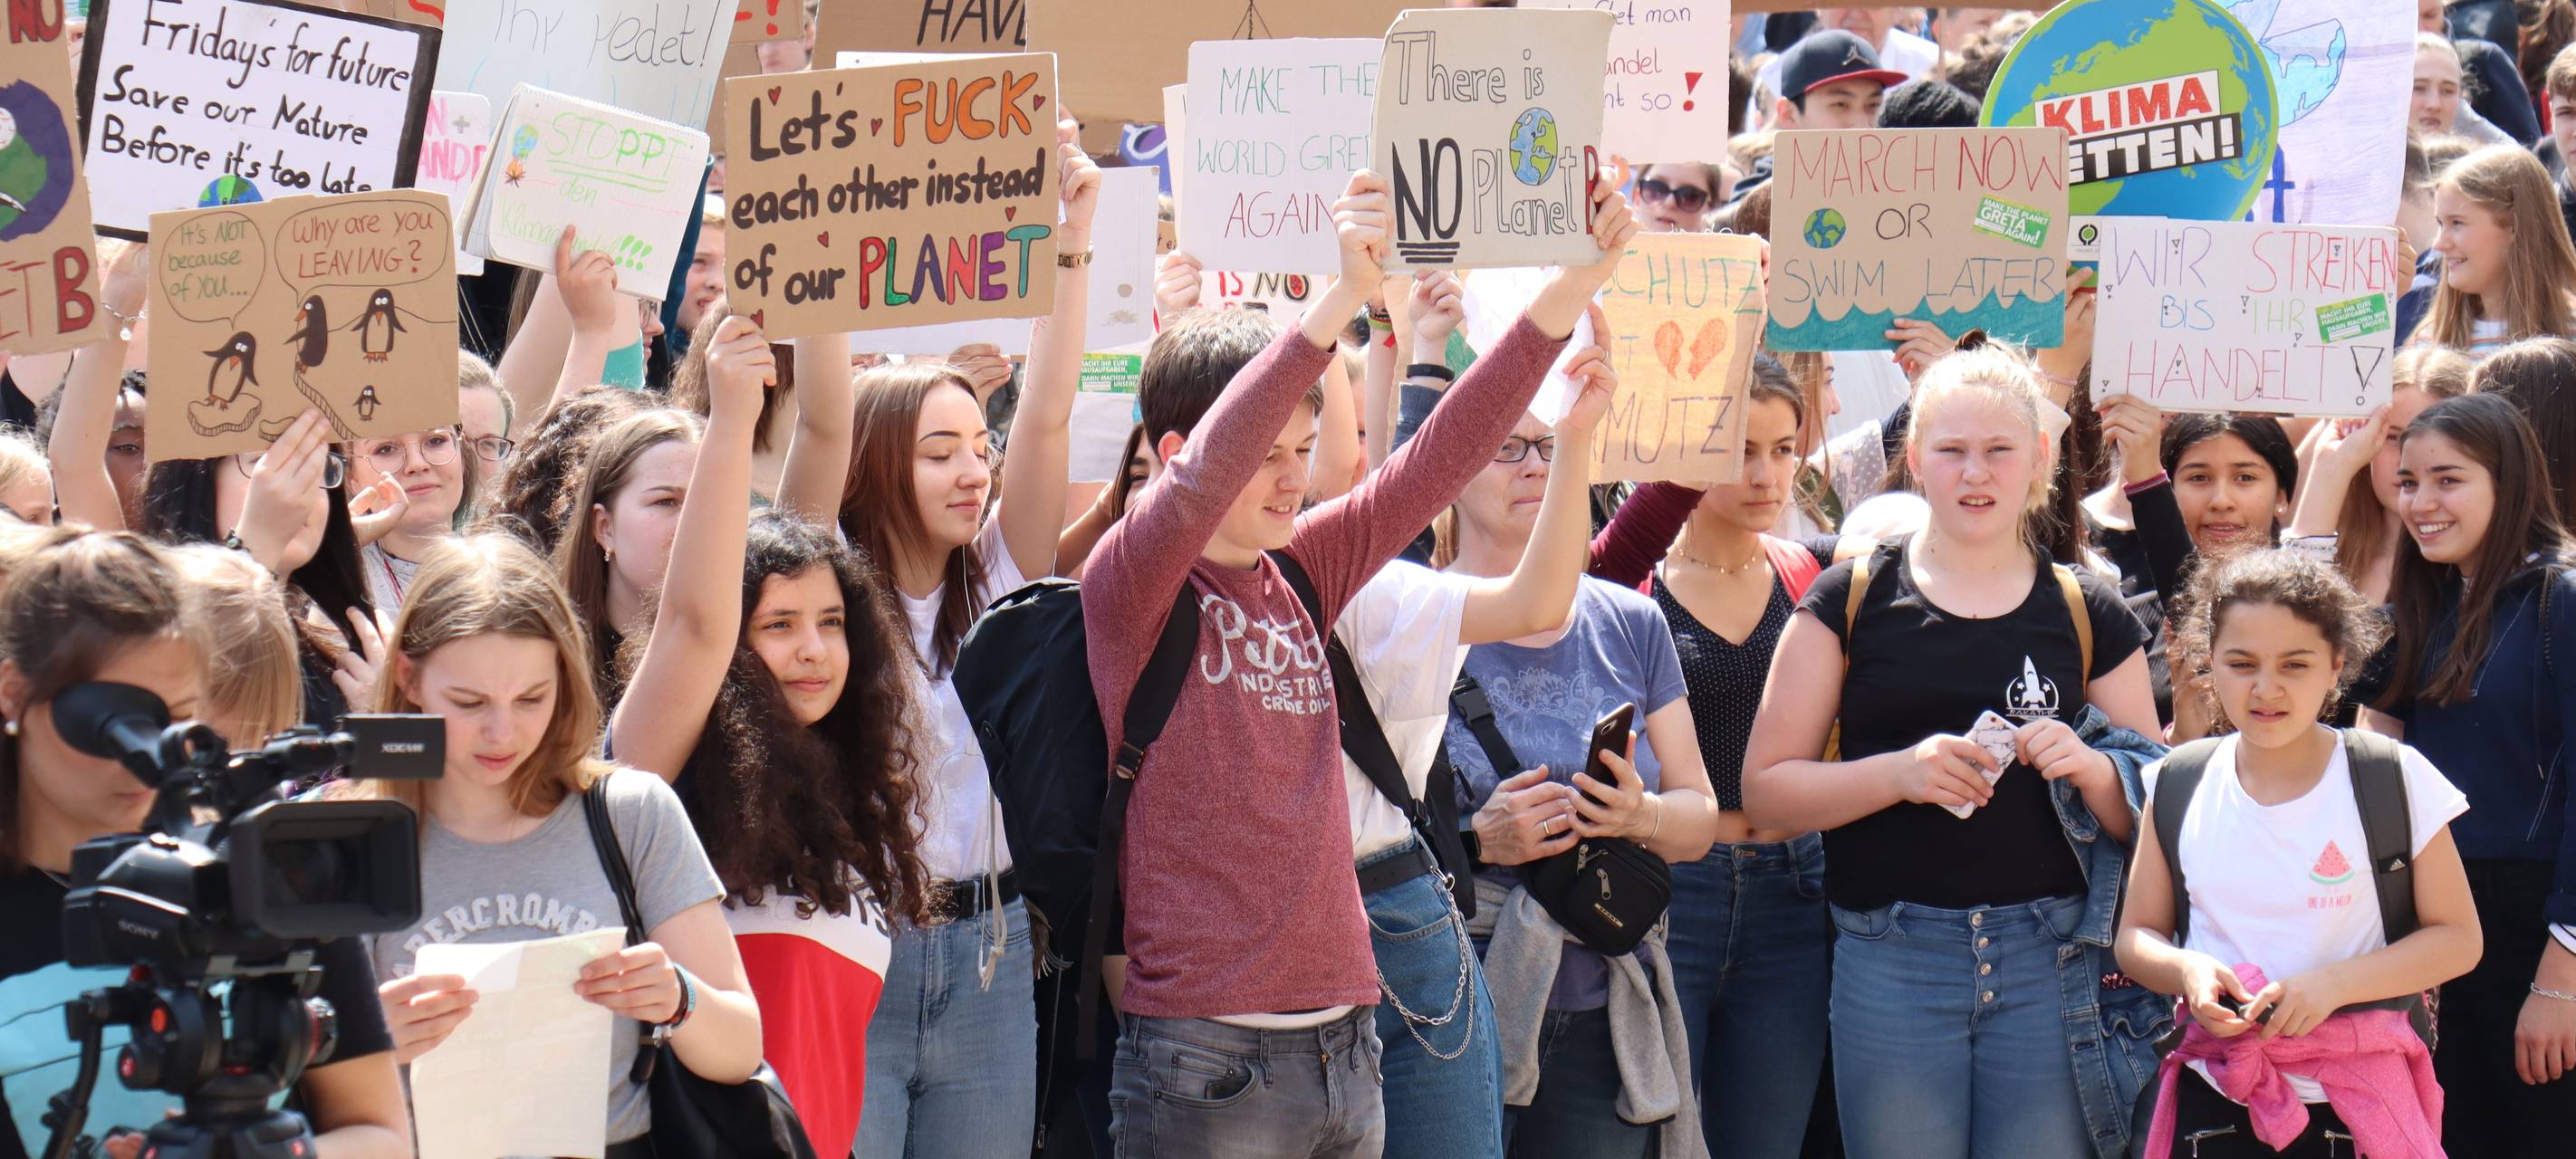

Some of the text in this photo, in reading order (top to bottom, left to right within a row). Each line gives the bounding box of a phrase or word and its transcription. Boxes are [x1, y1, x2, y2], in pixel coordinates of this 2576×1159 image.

[587, 0, 721, 68] redet!
[1646, 7, 1691, 23] man
[286, 22, 323, 74] for
[327, 36, 410, 91] future
[1391, 31, 1544, 104] There is
[102, 64, 368, 145] Save our Nature
[749, 82, 858, 161] Let's
[894, 71, 1038, 147] FUCK
[1219, 66, 1293, 115] MAKE
[1309, 62, 1379, 96] THE
[2043, 77, 2213, 137] KLIMA
[101, 114, 211, 170] Before
[224, 141, 262, 179] it's
[270, 149, 312, 189] too
[545, 112, 687, 177] STOPPT
[1197, 138, 1286, 177] WORLD
[1790, 133, 2064, 200] MARCH NOW
[560, 177, 598, 206] den
[732, 148, 1045, 229] each other instead
[1392, 138, 1463, 241] NO
[1472, 146, 1578, 236] Planet
[1984, 198, 2049, 225] MAKE THE PLANET
[215, 219, 249, 242] NOT
[293, 211, 433, 249] Why are you
[1876, 203, 1933, 239] OR
[1981, 206, 2026, 232] GRETA
[2004, 227, 2042, 244] AGAIN!
[168, 249, 242, 273] because
[299, 239, 422, 279] LEAVING?
[734, 225, 1052, 310] of our PLANET
[1784, 257, 2058, 302] SWIM LATER
[2113, 226, 2398, 294] WIR STREIKEN
[169, 274, 193, 302] of
[2159, 294, 2215, 330] BIS
[2254, 298, 2305, 335] IHR
[2125, 340, 2339, 403] HANDELT
[1200, 594, 1325, 684] Petro
